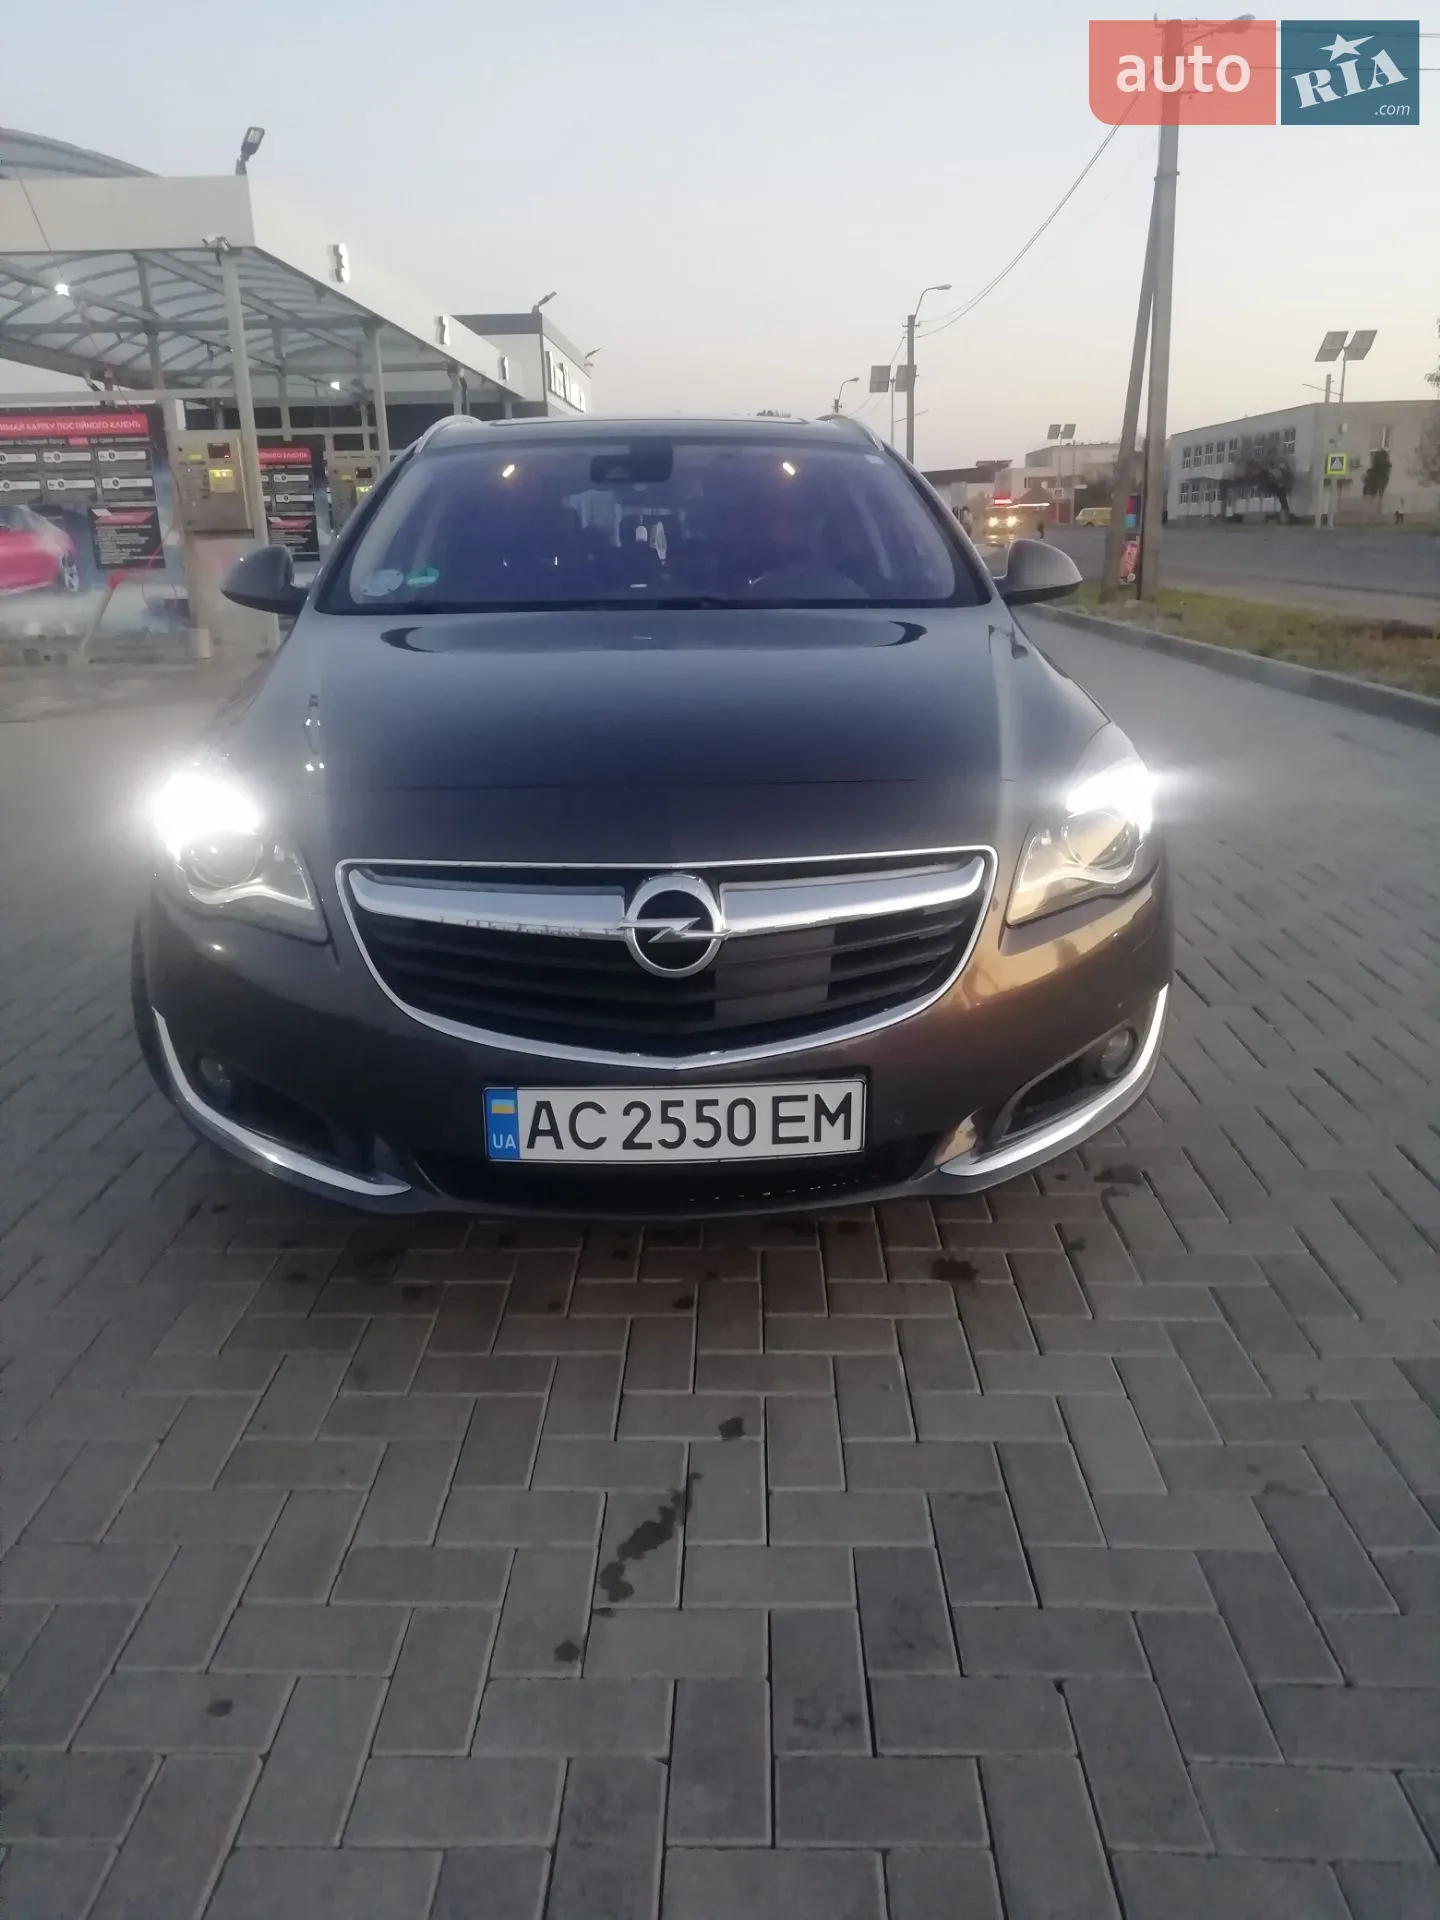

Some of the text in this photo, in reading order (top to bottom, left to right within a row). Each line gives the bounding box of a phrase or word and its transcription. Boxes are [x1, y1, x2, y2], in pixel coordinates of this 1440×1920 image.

[526, 1092, 853, 1150] AC 2550 EM
[492, 1133, 516, 1149] UA
